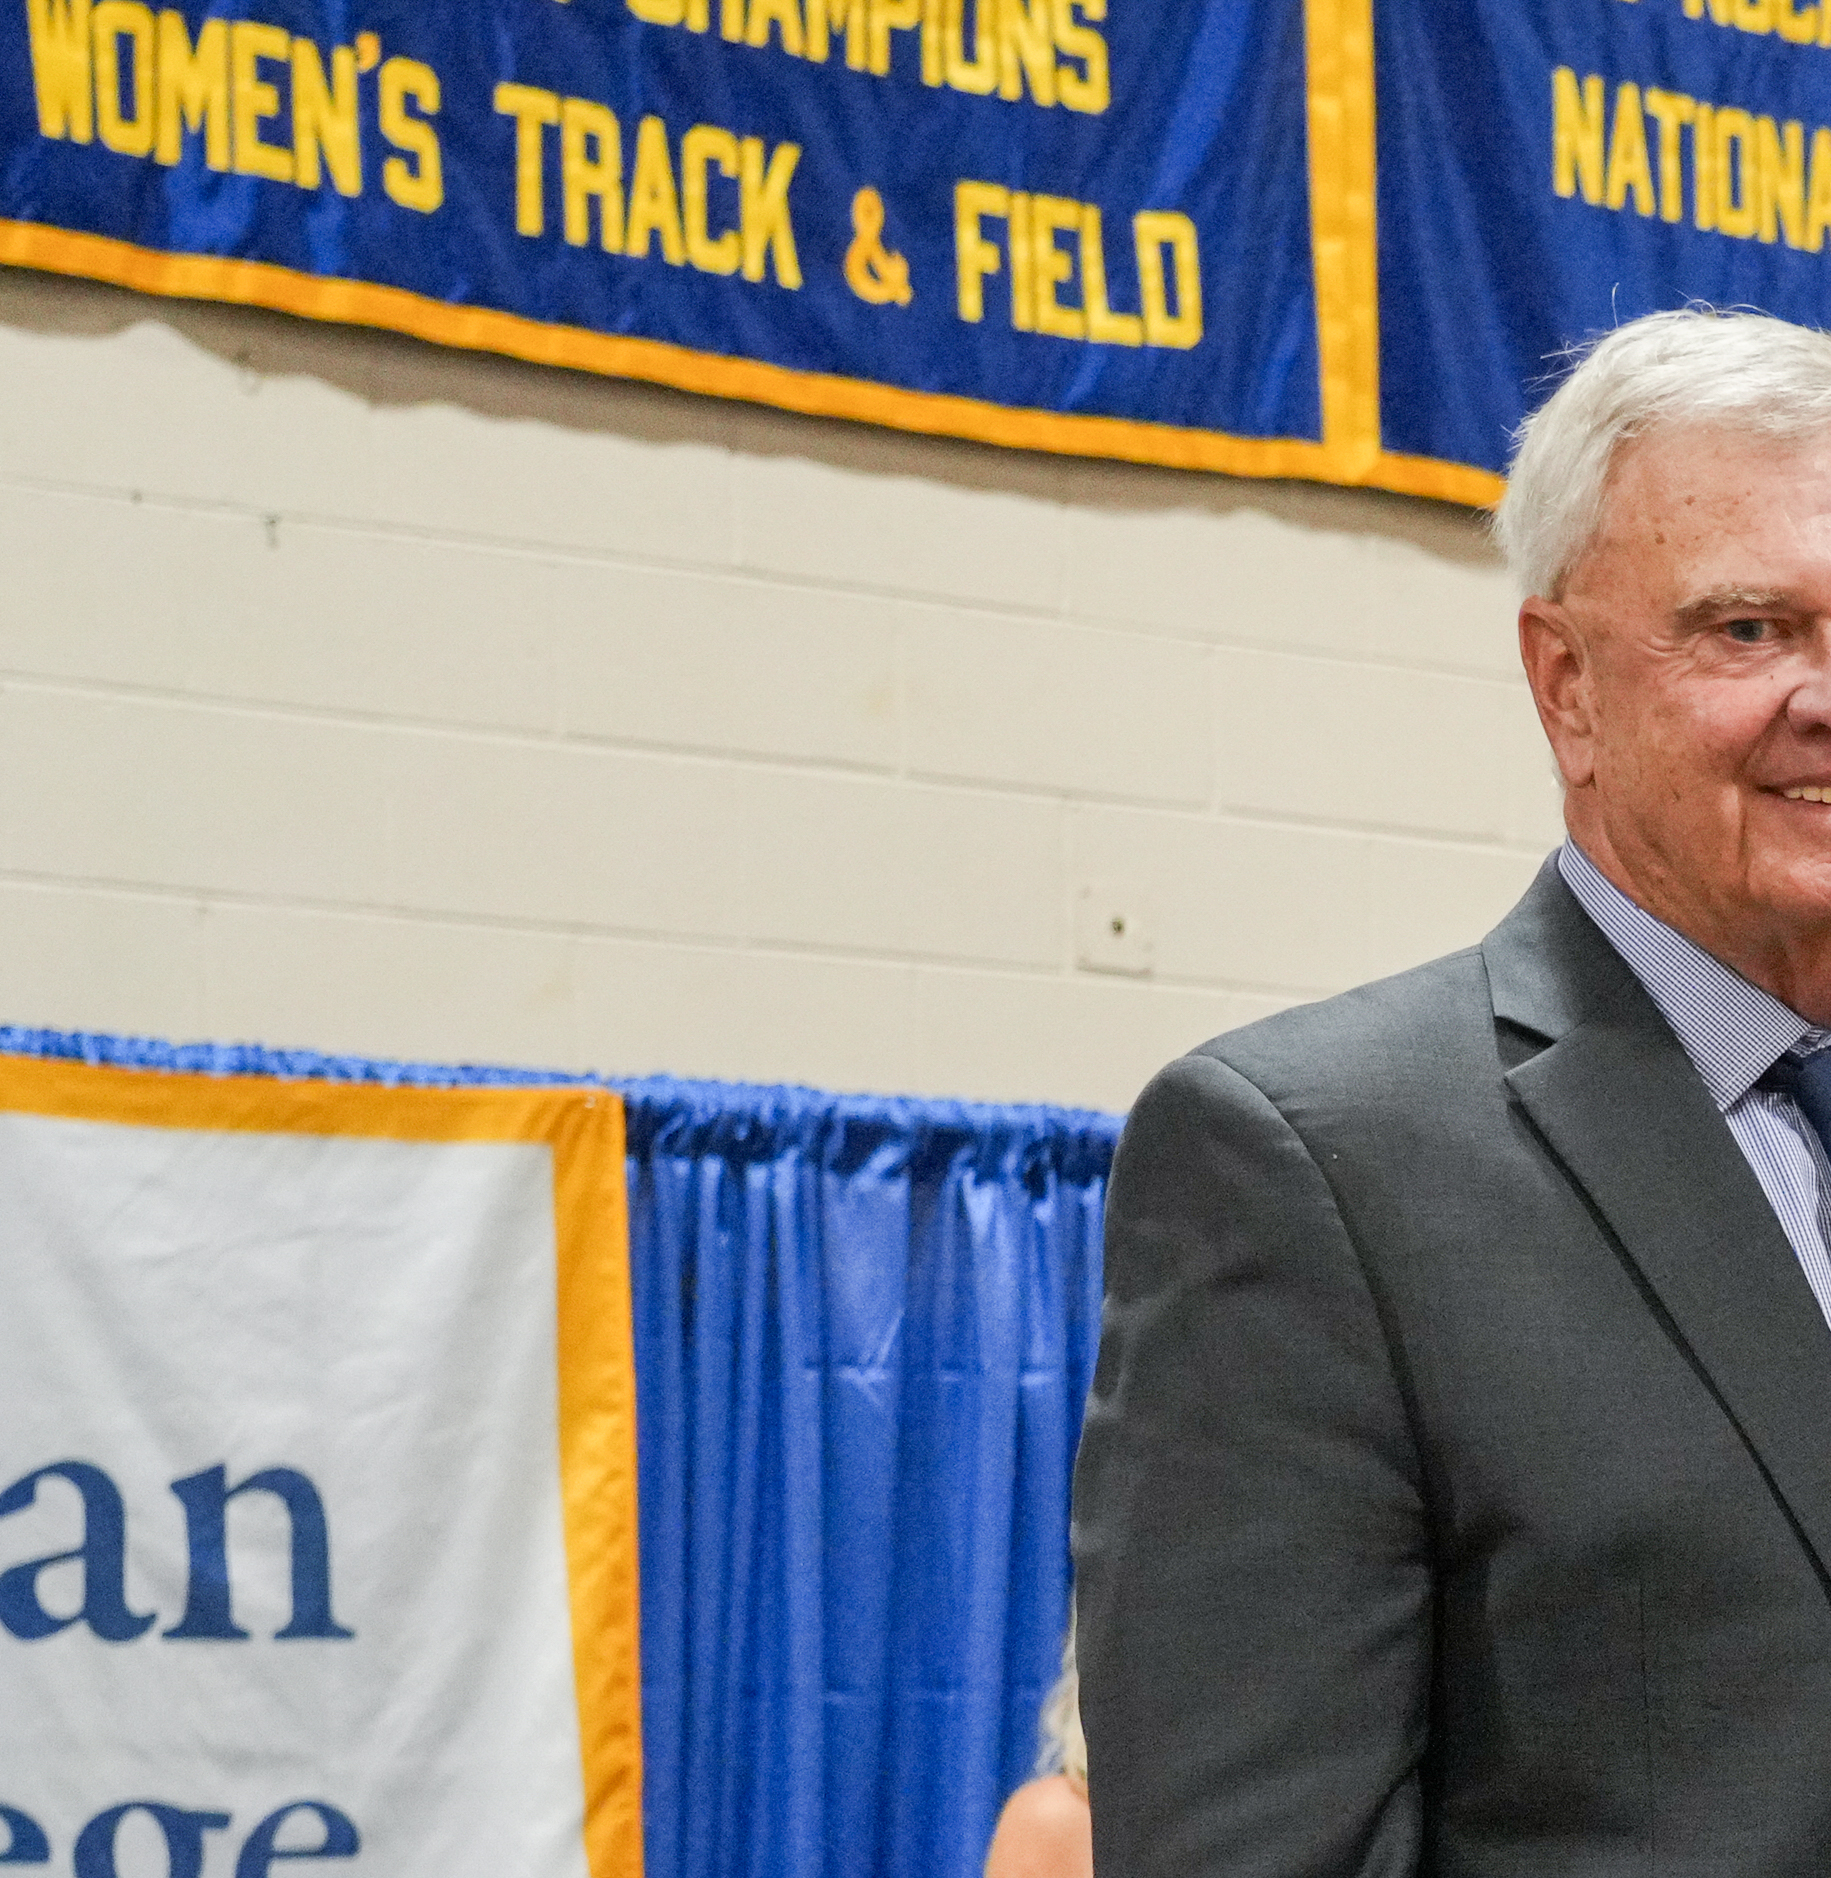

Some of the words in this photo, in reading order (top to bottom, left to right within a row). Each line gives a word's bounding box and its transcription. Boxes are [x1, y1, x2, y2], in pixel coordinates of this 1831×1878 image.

[27, 0, 443, 213] WOMEN'S
[494, 82, 802, 289] TRACK
[844, 187, 912, 306] &
[954, 179, 1201, 349] FIELD
